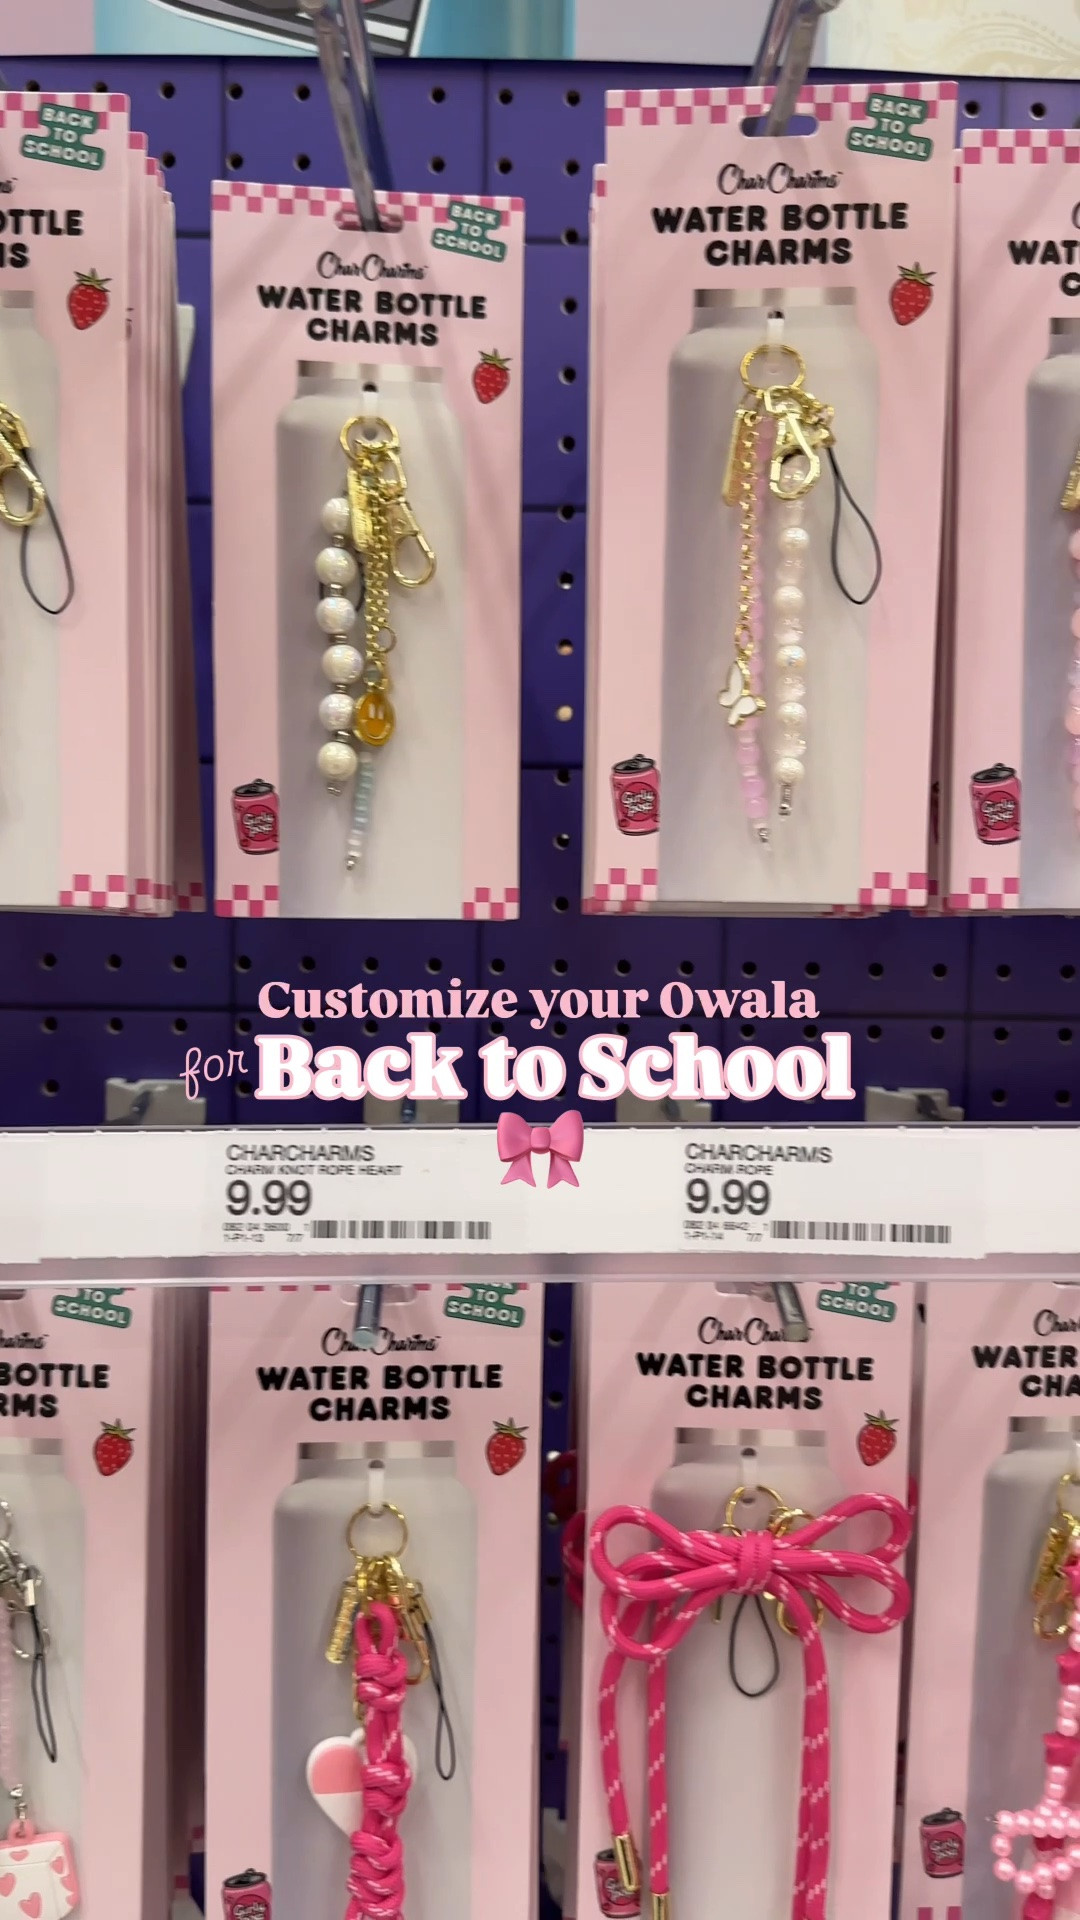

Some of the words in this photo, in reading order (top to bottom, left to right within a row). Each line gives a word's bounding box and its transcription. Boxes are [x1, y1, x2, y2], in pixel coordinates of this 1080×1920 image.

[42, 108, 94, 129] BACK
[870, 98, 922, 119] BACK
[53, 127, 77, 143] TO
[880, 118, 905, 134] TO
[24, 140, 100, 165] SCHOOL
[851, 132, 929, 157] SCHOOL
[451, 204, 496, 224] BACK
[651, 205, 767, 233] WATER
[781, 202, 909, 231] BOTTLE
[460, 222, 481, 237] TO
[434, 233, 503, 258] SCHOOL
[704, 237, 853, 266] CHARMS
[257, 284, 362, 313] WATER
[375, 290, 487, 319] BOTTLE
[306, 318, 438, 346] CHARMS
[225, 1144, 375, 1162] CHARCHARMS
[685, 1143, 833, 1163] CHARCHARMS
[224, 1164, 273, 1175] CHARM
[277, 1164, 314, 1175] KNOT
[318, 1165, 355, 1175] ROPE
[358, 1165, 402, 1176] HEART
[684, 1163, 733, 1175] CHARM
[736, 1164, 774, 1176] ROPE
[226, 1179, 312, 1216] 9.99
[686, 1178, 771, 1216] 9.99
[83, 1288, 105, 1303] TO
[476, 1288, 499, 1303] TO
[848, 1282, 870, 1298] TO
[54, 1299, 127, 1324] SCHOOL
[447, 1300, 520, 1324] SCHOOL
[820, 1294, 891, 1319] SCHOOL
[636, 1352, 744, 1378] WATER
[757, 1355, 875, 1381] BOTTLE
[971, 1345, 1078, 1368] WATER
[256, 1365, 369, 1391] WATER
[383, 1364, 503, 1389] BOTTLE
[309, 1396, 451, 1421] CHARMS
[685, 1384, 823, 1410] CHARMS
